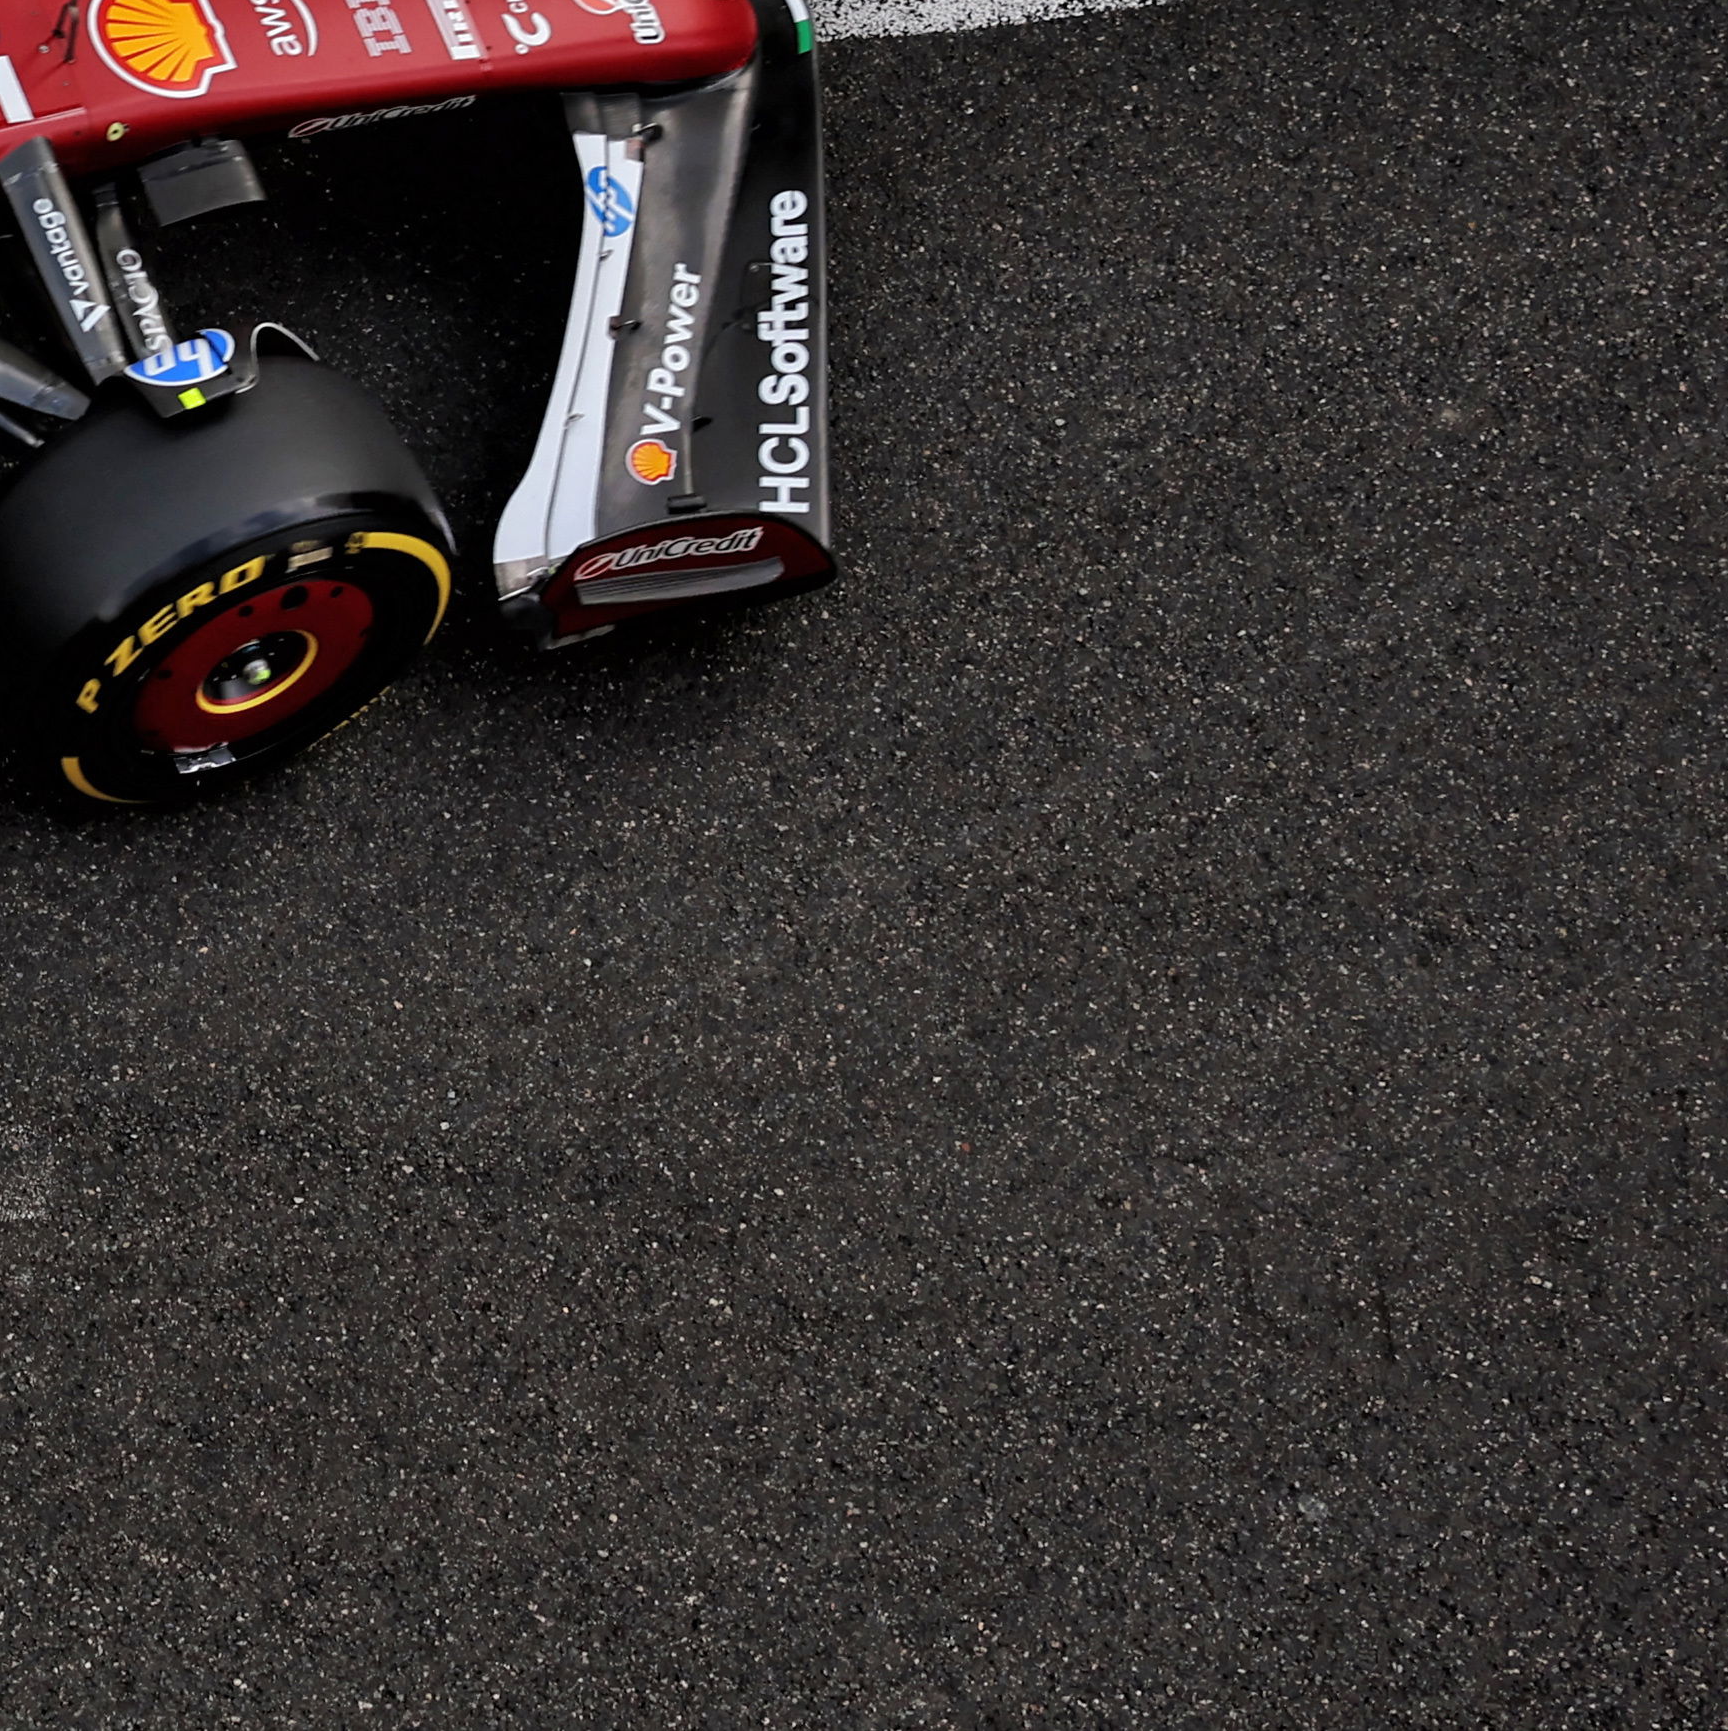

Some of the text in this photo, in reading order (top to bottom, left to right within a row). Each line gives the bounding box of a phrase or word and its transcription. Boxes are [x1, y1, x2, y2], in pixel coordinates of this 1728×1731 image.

[326, 95, 478, 130] UniCredit
[116, 248, 173, 352] SPACIO
[641, 262, 702, 437] V-Power
[758, 189, 810, 513] HCLSoftware
[615, 526, 765, 569] UniCredit
[75, 678, 102, 714] P
[104, 555, 269, 677] ZERO
